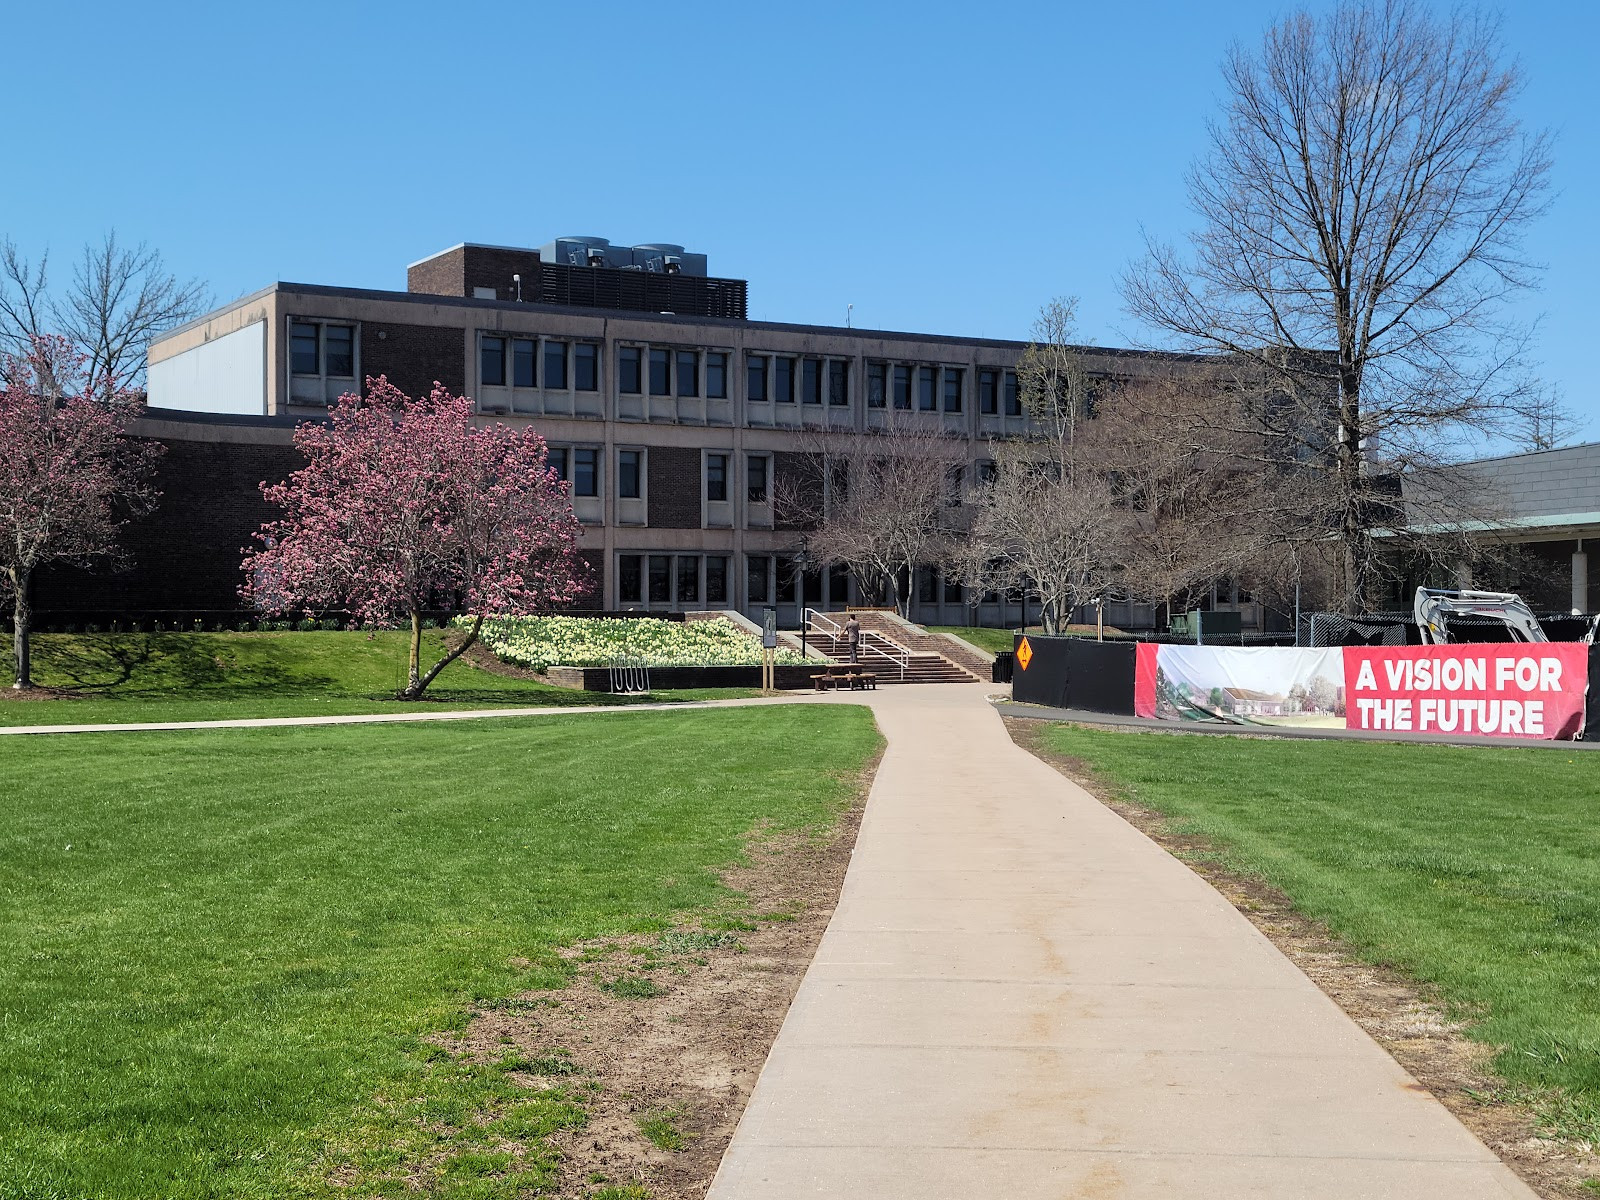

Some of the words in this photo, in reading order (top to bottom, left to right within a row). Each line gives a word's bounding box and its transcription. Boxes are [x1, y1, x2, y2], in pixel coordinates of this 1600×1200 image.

[1355, 660, 1377, 691] A
[1384, 658, 1486, 691] VISION
[1496, 657, 1562, 691] FOR
[1357, 698, 1412, 730] THE
[1419, 699, 1544, 734] FUTURE
